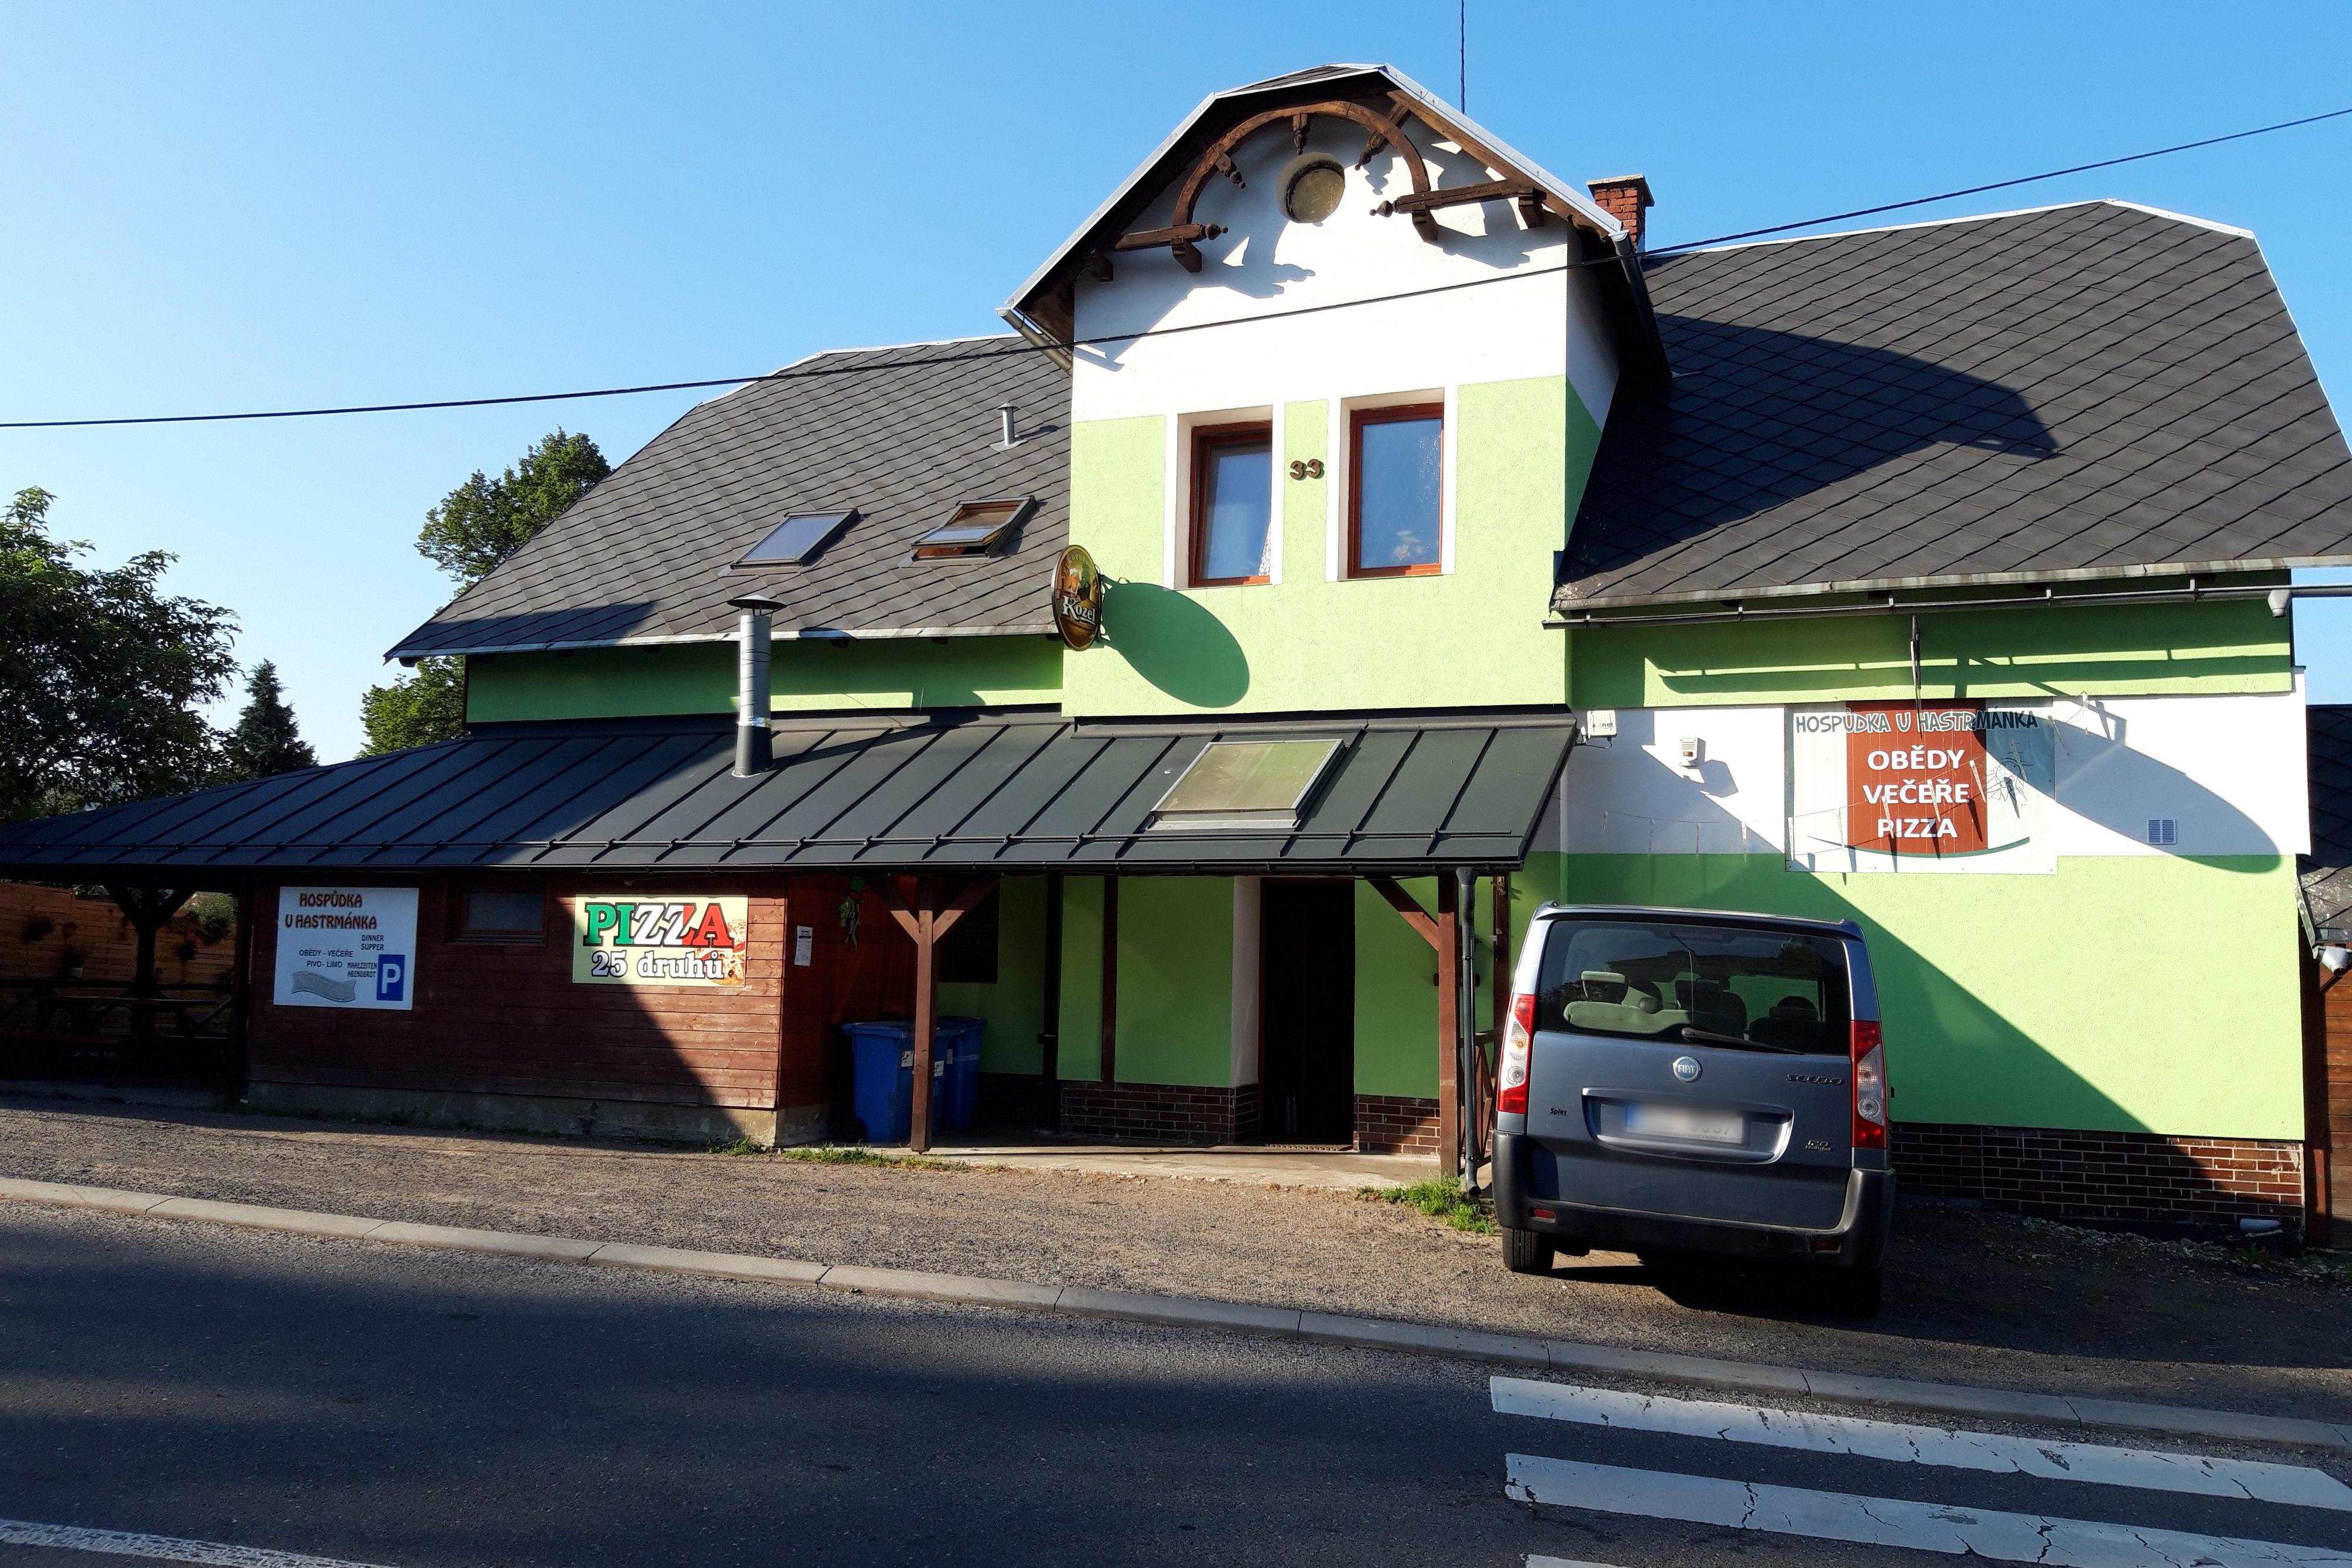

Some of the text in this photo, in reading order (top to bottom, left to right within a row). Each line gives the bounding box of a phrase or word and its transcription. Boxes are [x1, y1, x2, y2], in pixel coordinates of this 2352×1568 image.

[1289, 459, 1322, 480] 33
[1062, 595, 1096, 623] Kozel
[1796, 706, 2039, 734] HOSPŮDKA U HASTRMÁNKA
[1867, 745, 1965, 770] OBĚDY
[1863, 778, 1970, 804] VEČEŘE
[1877, 818, 1958, 838] PIZZA
[299, 890, 362, 908] HOSPŮDKA
[285, 912, 377, 930] U HASTRMÁNKA
[583, 902, 734, 948] PIZZA
[328, 948, 354, 957] VEČEŘE
[592, 950, 724, 979] 25 druhů
[381, 964, 401, 994] P
[1678, 1064, 1696, 1074] FIAT
[1785, 1074, 1845, 1086] SCUDO
